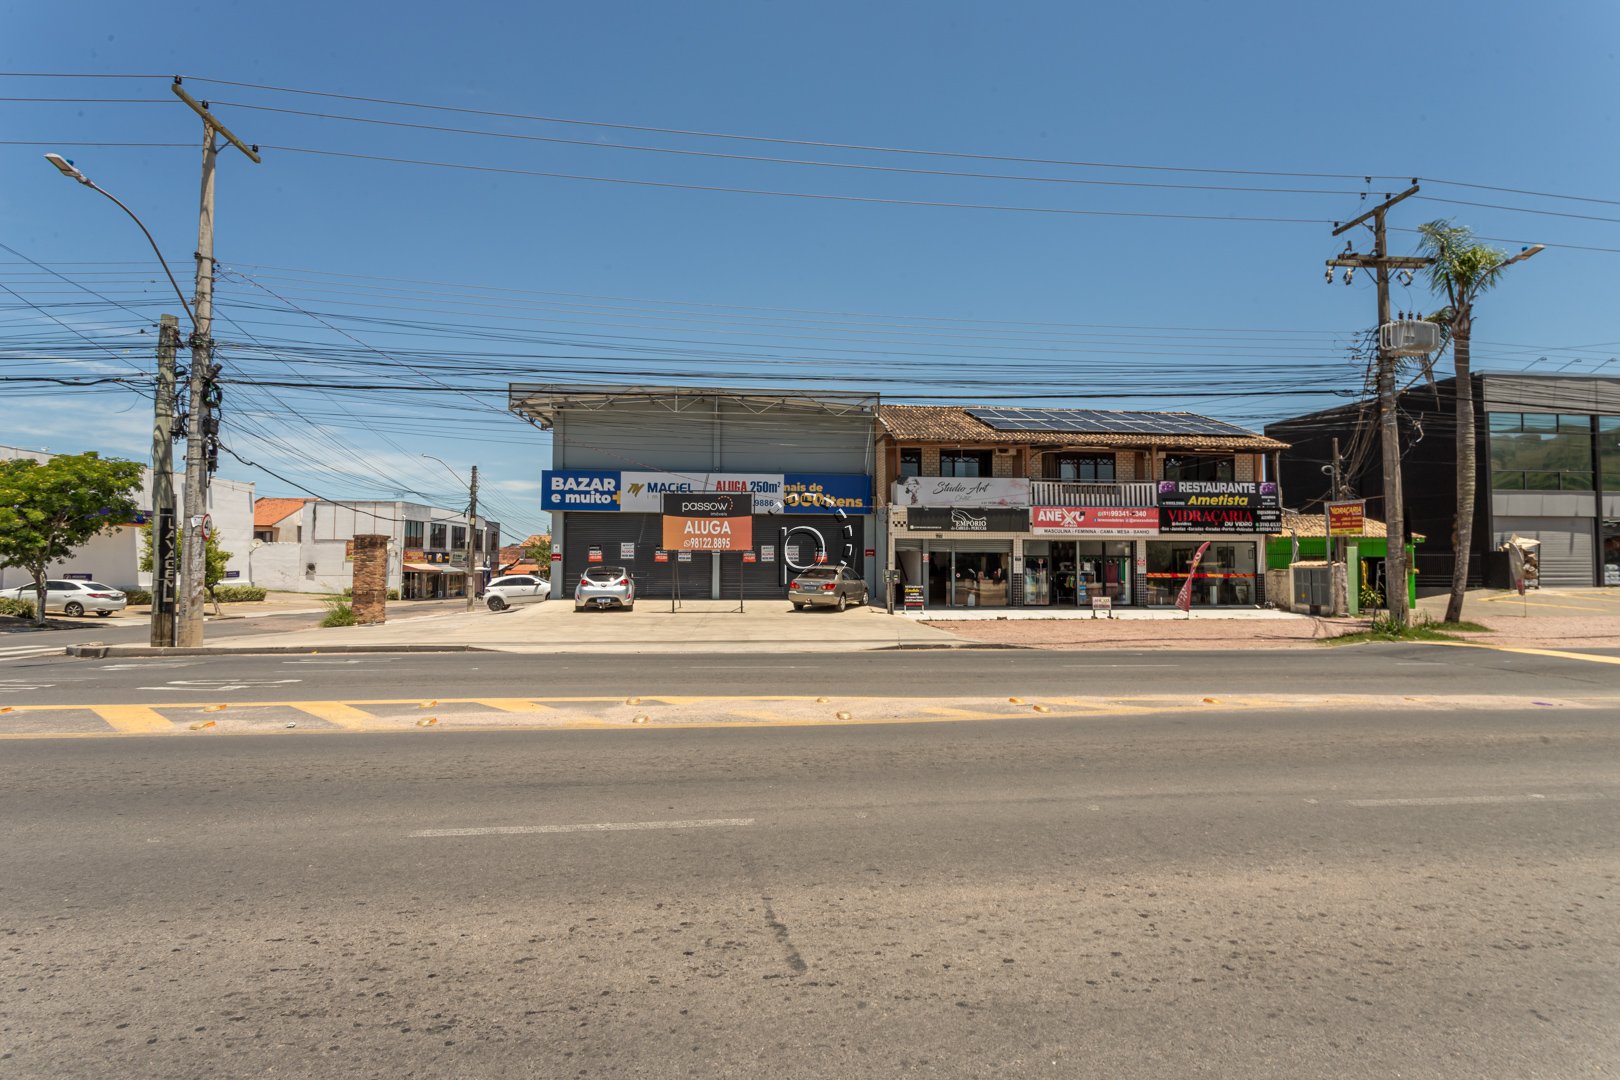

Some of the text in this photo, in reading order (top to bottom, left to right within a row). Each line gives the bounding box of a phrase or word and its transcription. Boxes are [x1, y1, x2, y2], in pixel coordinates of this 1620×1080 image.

[551, 477, 616, 491] BAZAR
[716, 480, 748, 493] ALUGA
[809, 483, 824, 492] de
[933, 481, 991, 495] Studio Art
[1179, 482, 1256, 493] RESTAURANTE
[551, 493, 562, 504] e
[1188, 494, 1249, 506] Ametista
[682, 502, 728, 512] passow
[1168, 509, 1253, 525] VIDRAÇARIA
[684, 520, 732, 535] ALUGA
[956, 519, 987, 527] EMPÓRIO
[690, 538, 732, 549] 98122.8895
